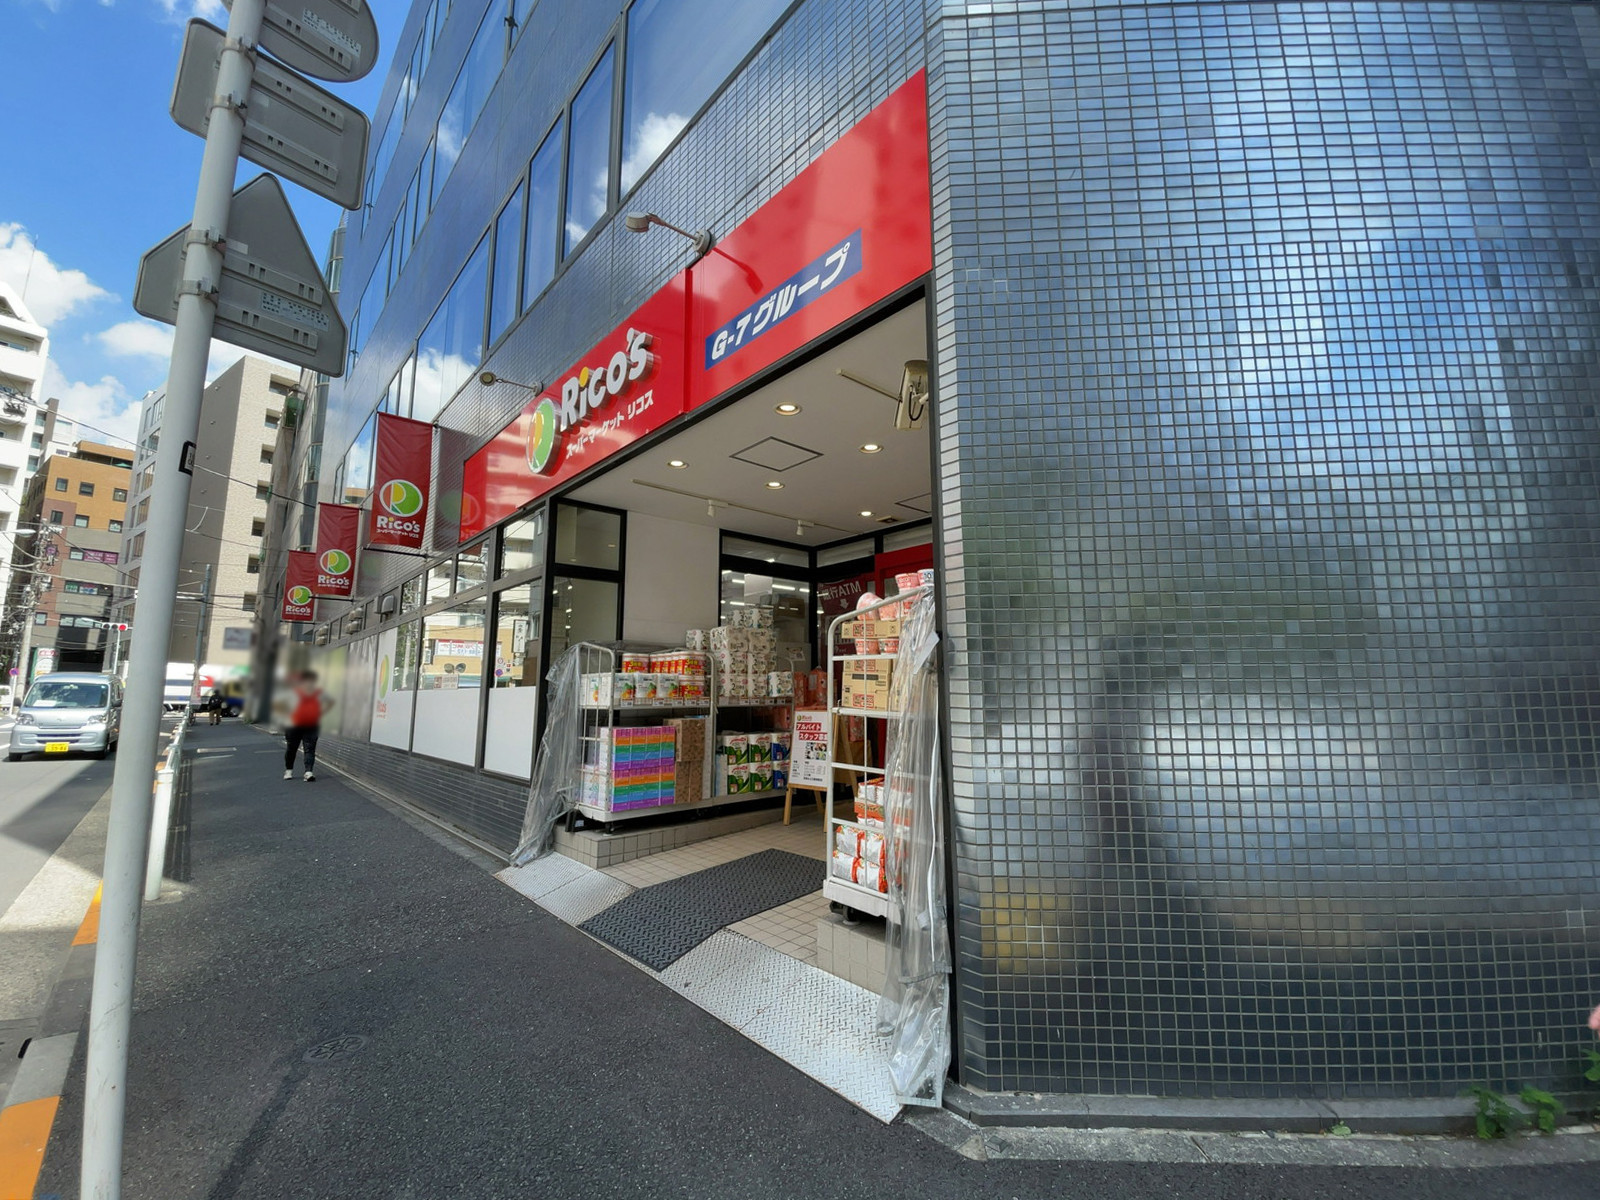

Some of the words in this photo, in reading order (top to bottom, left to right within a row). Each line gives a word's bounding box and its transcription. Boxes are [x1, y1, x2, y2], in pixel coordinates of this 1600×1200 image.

[711, 242, 851, 360] G-7グループ
[560, 327, 648, 432] Rico's
[566, 412, 624, 459] スーパーマーケット
[628, 390, 653, 420] リコス
[377, 515, 420, 533] Rico's
[317, 574, 350, 586] Rico's
[285, 605, 311, 613] Rico's
